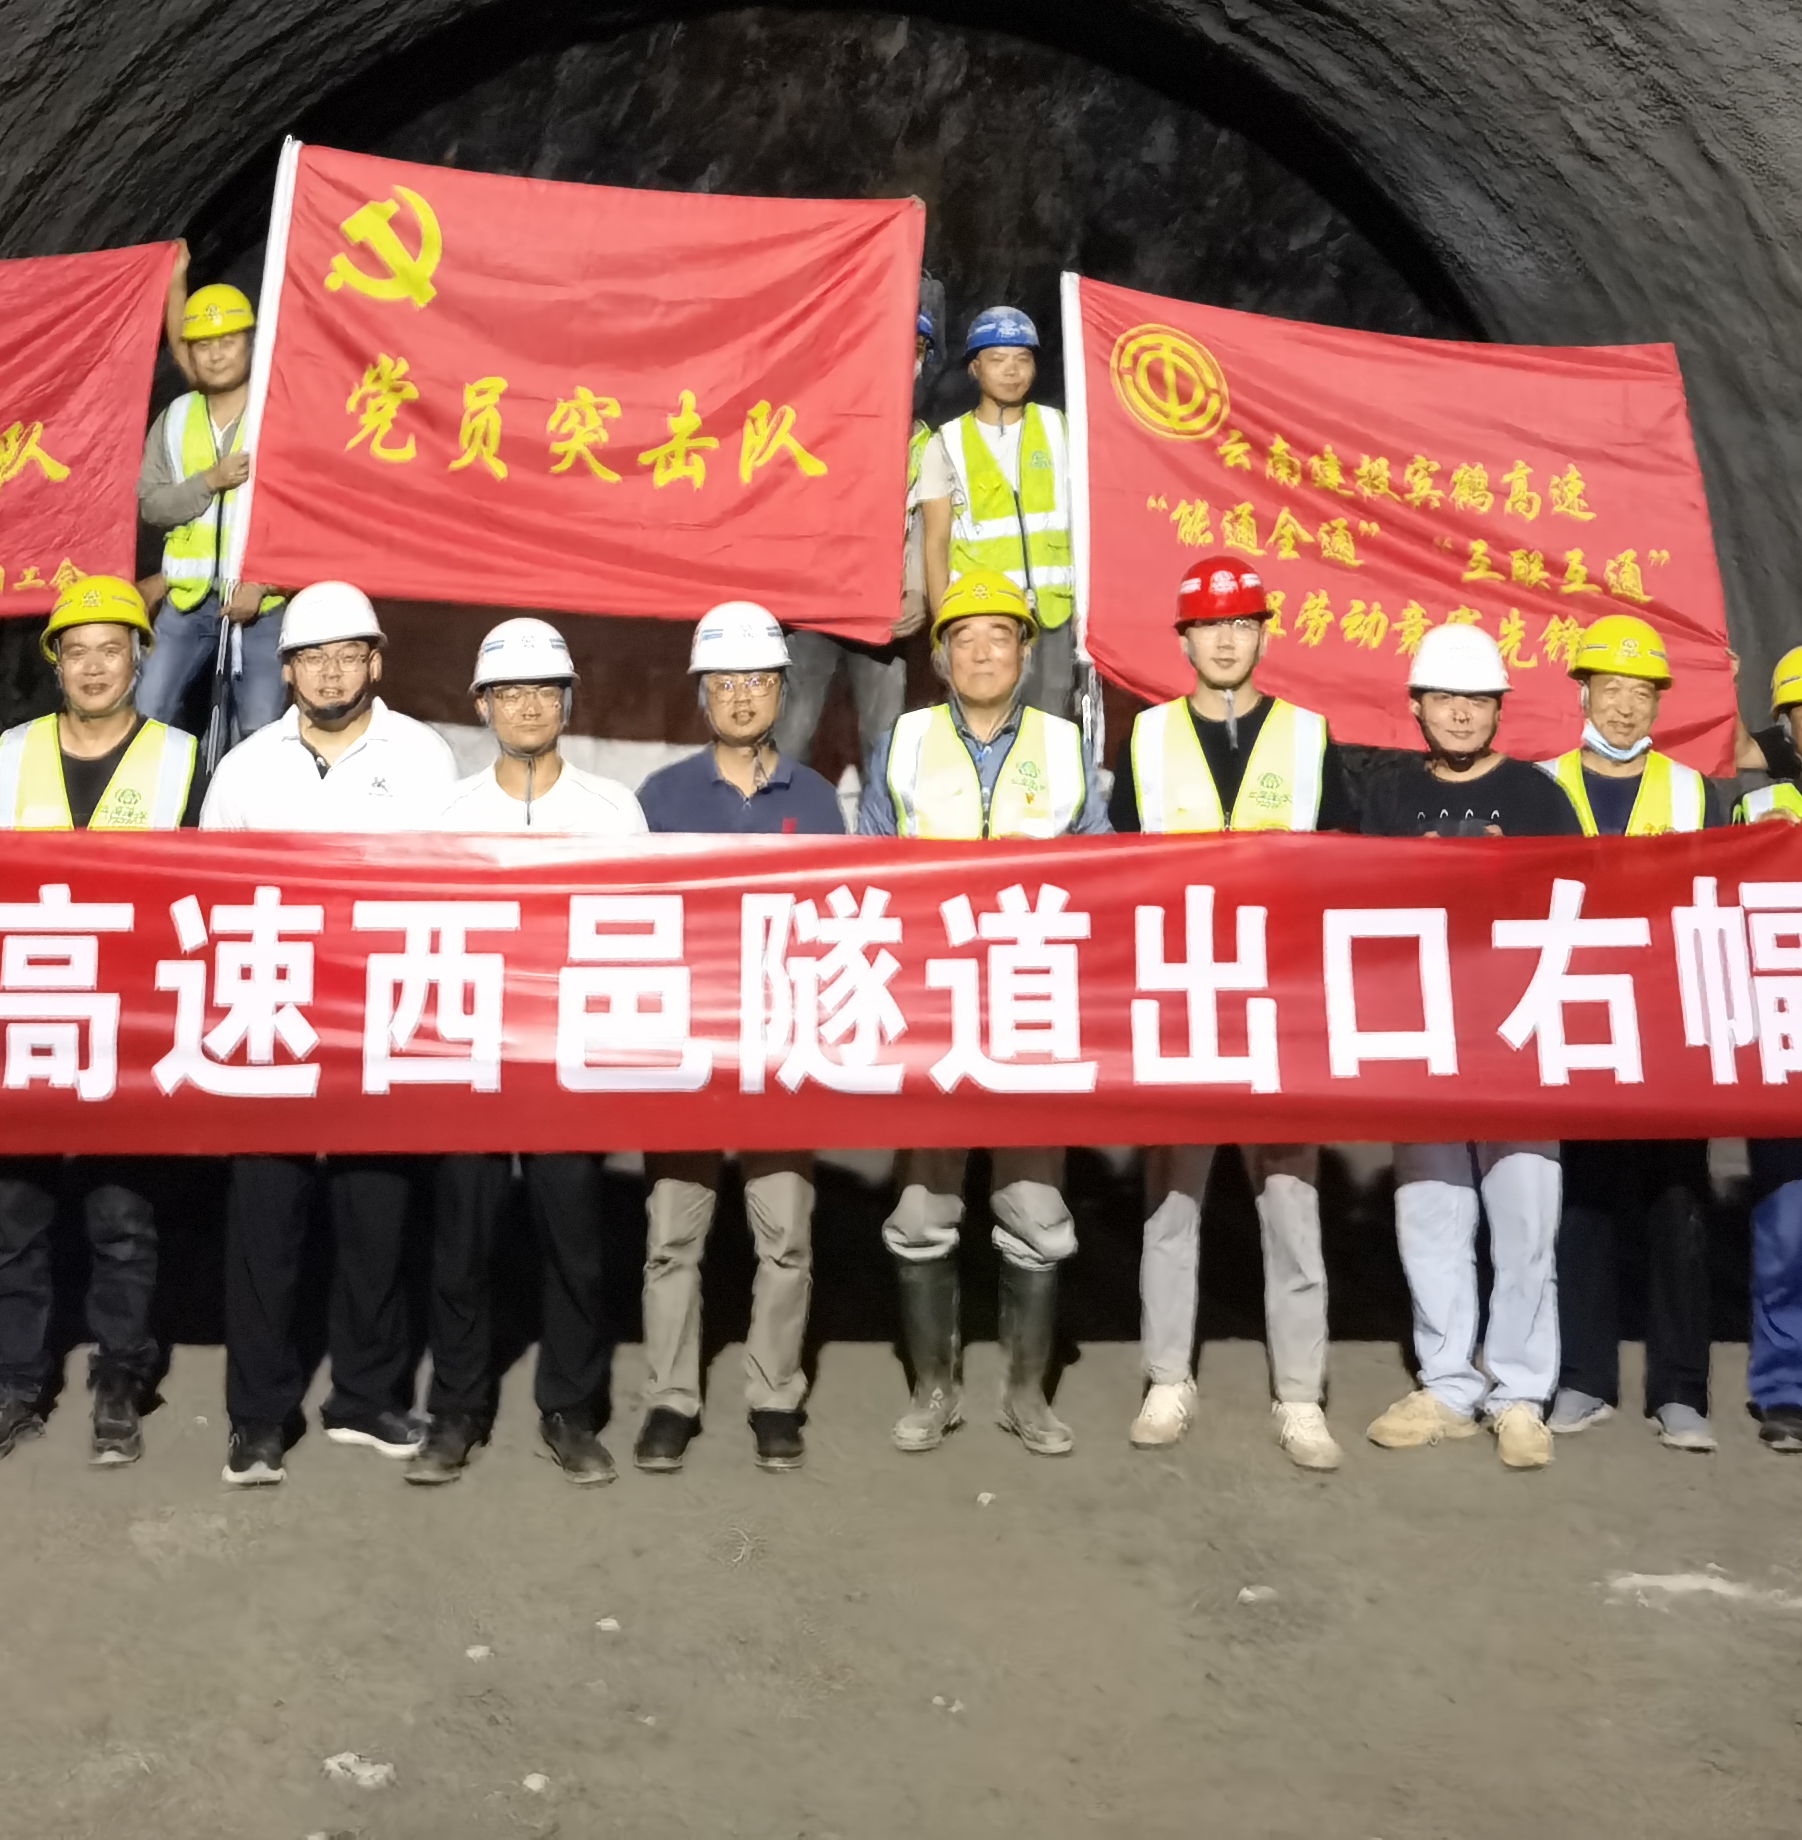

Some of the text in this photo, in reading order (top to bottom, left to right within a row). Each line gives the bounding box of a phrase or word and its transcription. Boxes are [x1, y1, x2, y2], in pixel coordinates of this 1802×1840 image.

[345, 353, 829, 490] 党员突击队
[1217, 429, 1597, 522] 云南建投宾鹤高速
